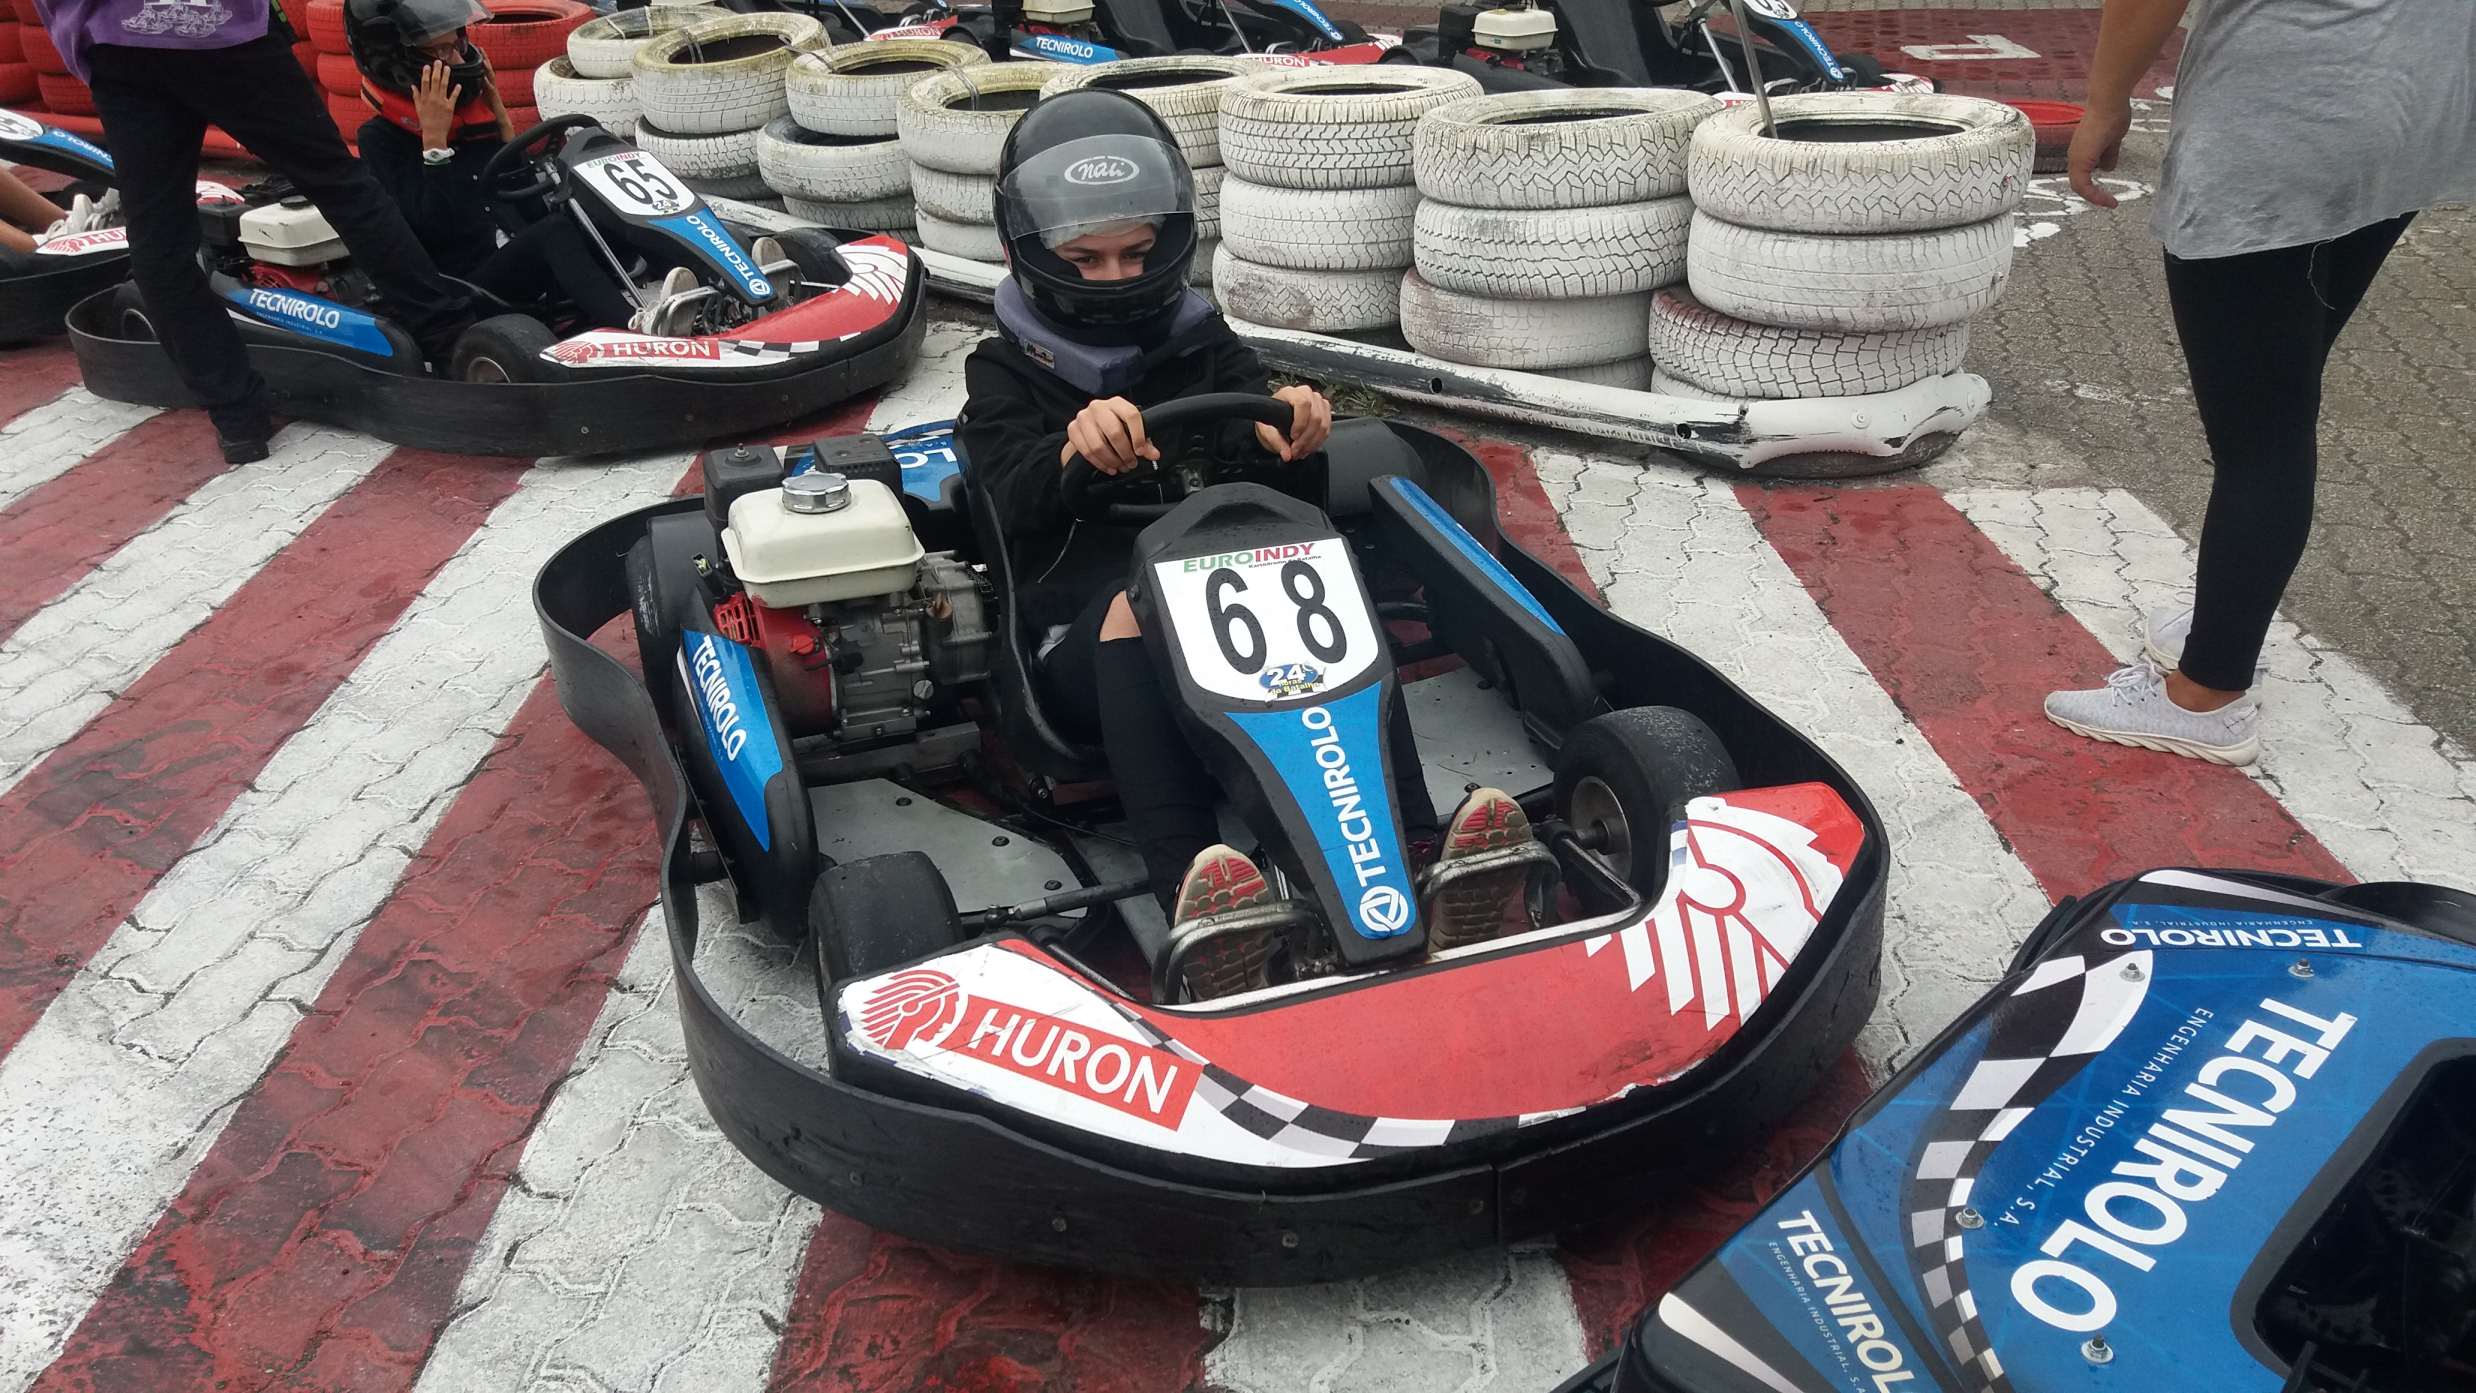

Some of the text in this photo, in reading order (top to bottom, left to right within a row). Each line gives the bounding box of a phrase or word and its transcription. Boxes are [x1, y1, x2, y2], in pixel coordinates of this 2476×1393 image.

[1036, 36, 1094, 58] TECNIROLO
[604, 160, 678, 205] 65
[686, 215, 754, 280] TECNIROLO
[249, 288, 340, 329] TECNIROLO
[613, 341, 710, 357] HURON
[1183, 543, 1316, 573] EUROINDY
[692, 635, 747, 761] TECNIROLO
[1267, 664, 1306, 687] 24
[1302, 706, 1386, 888] TECNIROLO
[2101, 928, 2361, 947] TECNIROLO
[968, 1008, 1178, 1114] HURON
[1993, 1007, 2215, 1227] ENGENHARIA INDUSTRIAL, S.A.
[2011, 998, 2357, 1332] TECNIROLO
[1768, 1241, 1811, 1304] ENGENHARIA
